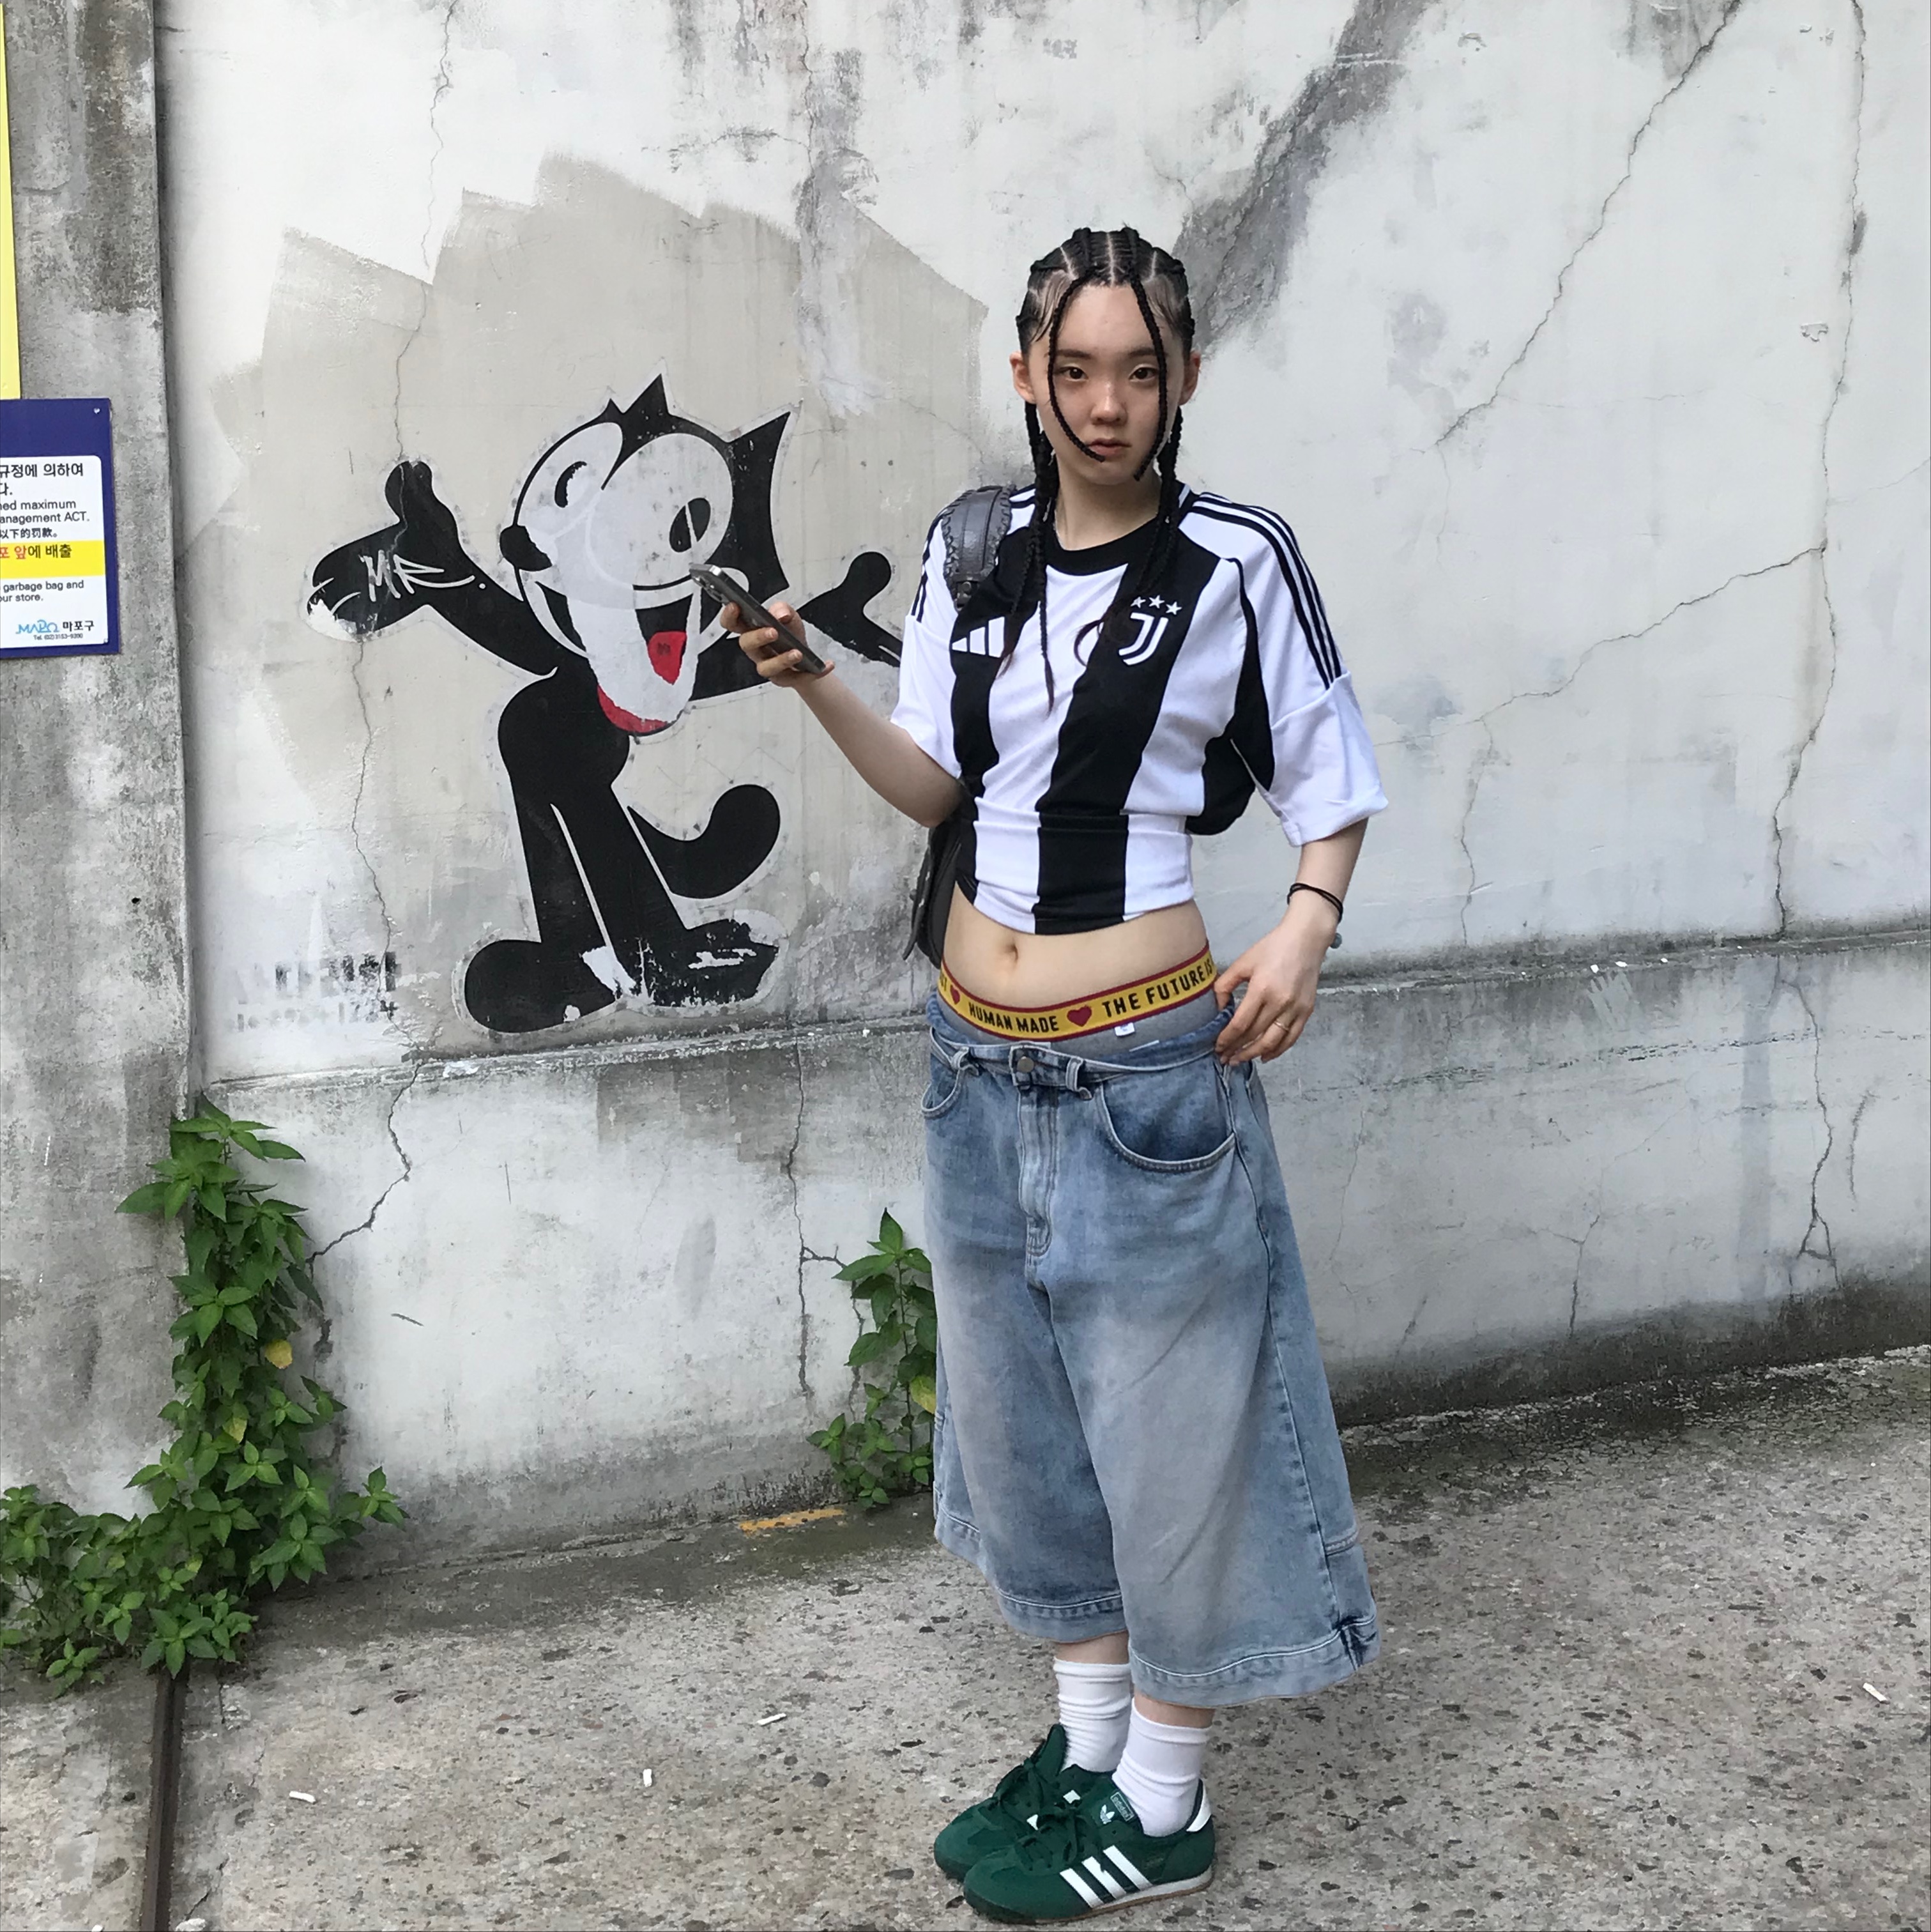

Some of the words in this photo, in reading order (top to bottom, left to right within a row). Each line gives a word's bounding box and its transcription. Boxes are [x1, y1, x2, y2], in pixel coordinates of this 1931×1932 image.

[0, 464, 37, 479] 규정에
[43, 463, 83, 477] 의하여
[0, 500, 17, 510] ed
[20, 498, 76, 510] maximum
[64, 511, 90, 521] ACT.
[14, 545, 41, 560] 앞에
[45, 544, 72, 558] 배출
[3, 582, 42, 593] garbage
[45, 581, 63, 591] bag
[66, 579, 84, 589] and
[63, 620, 95, 632] 마포구
[1102, 992, 1141, 1018] THE
[1145, 965, 1206, 1005] FUTURE
[1203, 958, 1212, 977] IS
[968, 1001, 1013, 1031] HUMAN
[1016, 1015, 1060, 1033] MADE
